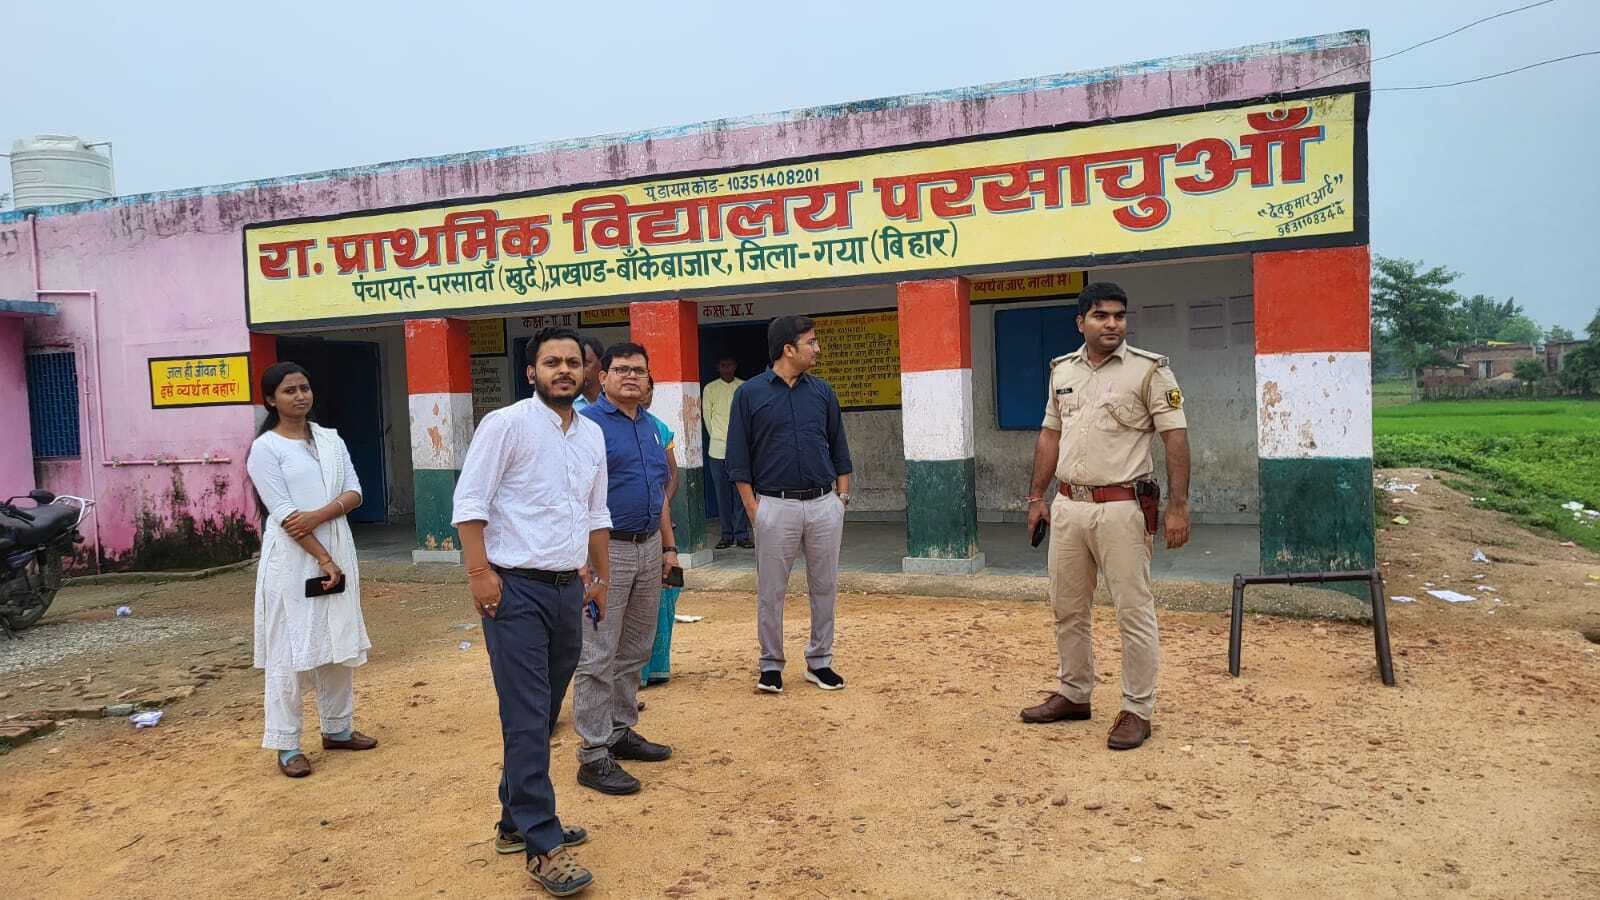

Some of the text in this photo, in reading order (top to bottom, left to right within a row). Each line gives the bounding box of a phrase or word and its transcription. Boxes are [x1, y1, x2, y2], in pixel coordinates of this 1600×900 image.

[258, 105, 1326, 279] रा. प्राथमिक विद्यालय परसाचुआँ
[727, 167, 819, 190] 10351408201
[871, 221, 958, 264] (बिहार)
[167, 366, 183, 379] जल
[195, 360, 217, 377] जीवन
